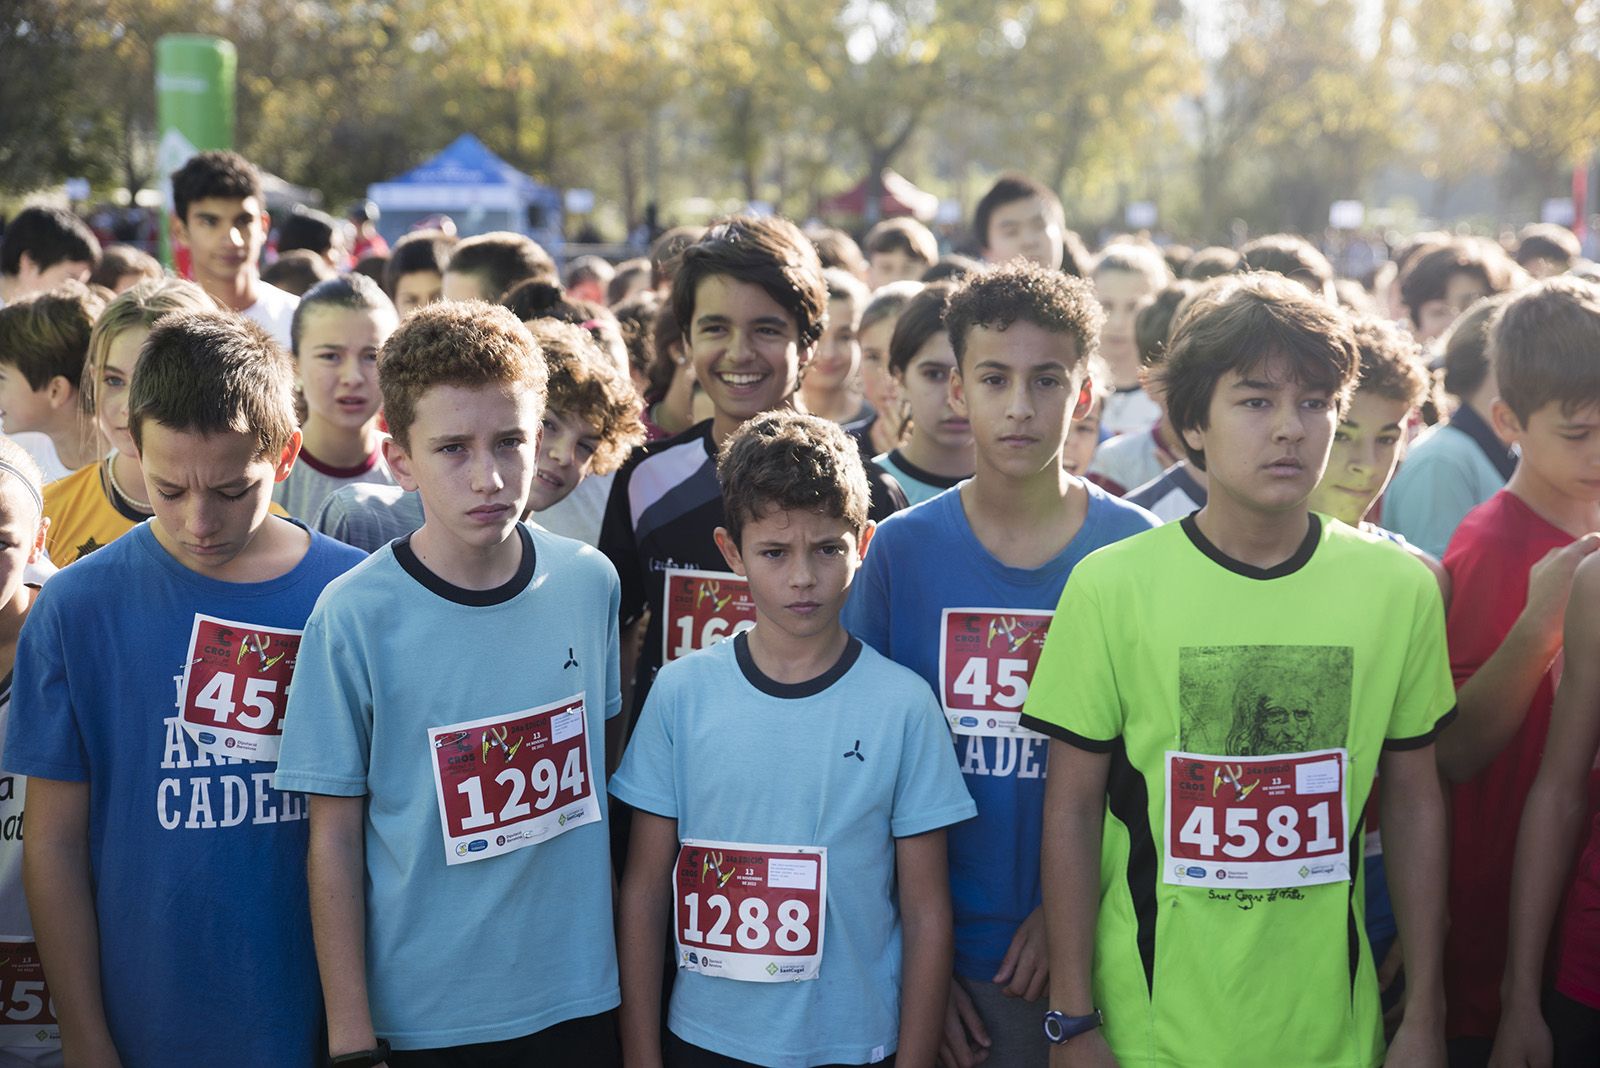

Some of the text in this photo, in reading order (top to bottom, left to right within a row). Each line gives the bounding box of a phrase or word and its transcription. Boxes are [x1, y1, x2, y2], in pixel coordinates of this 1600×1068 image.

[204, 645, 231, 657] CROS
[194, 671, 290, 730] 45
[533, 731, 541, 739] 13
[457, 747, 585, 831] 1294
[1179, 801, 1337, 859] 4581
[683, 892, 811, 952] 1288
